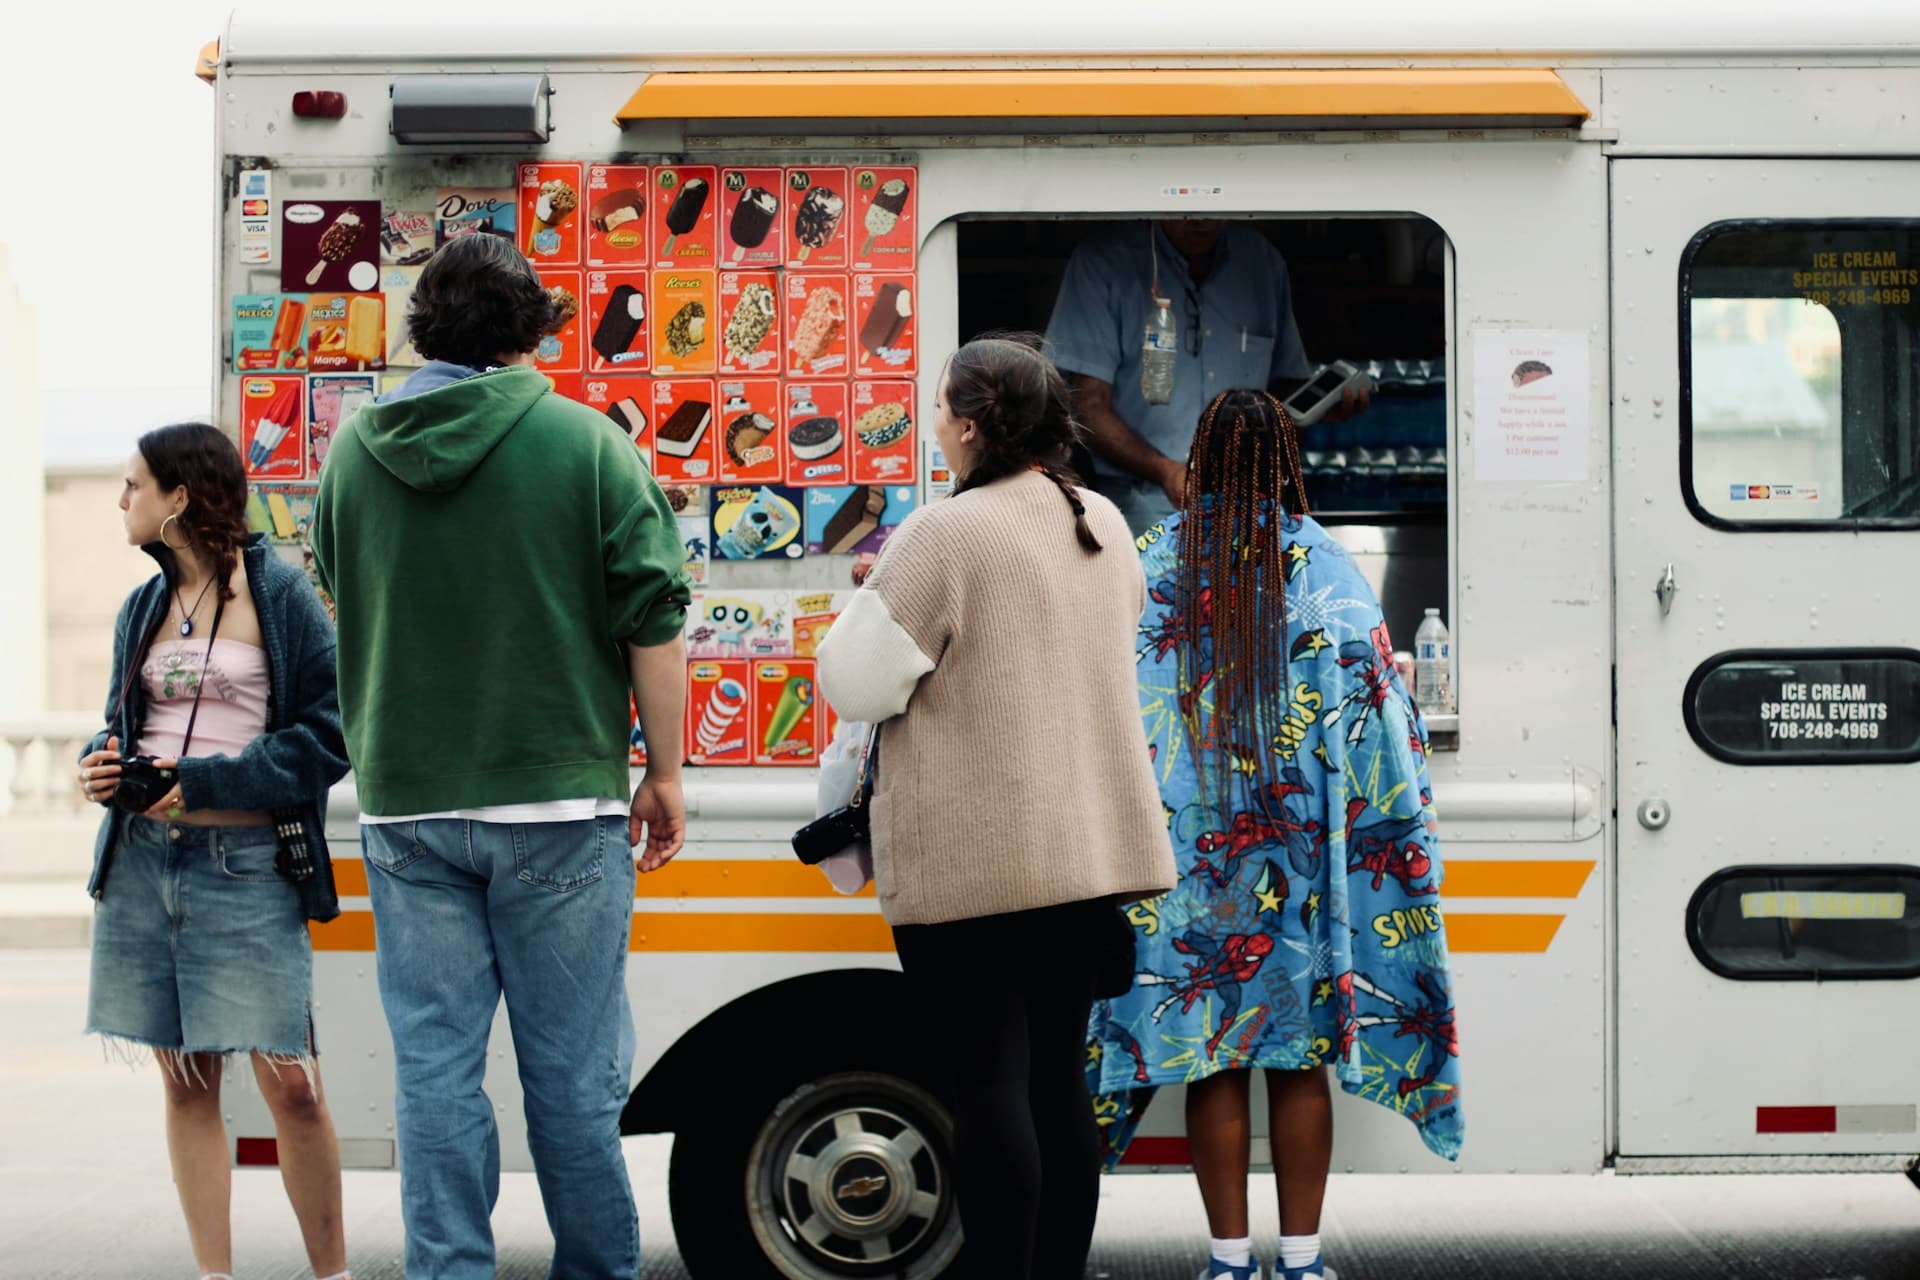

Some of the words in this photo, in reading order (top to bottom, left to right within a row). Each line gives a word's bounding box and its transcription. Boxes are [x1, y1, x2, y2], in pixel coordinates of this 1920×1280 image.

[438, 195, 510, 218] Dove
[246, 225, 267, 233] VISA
[385, 214, 428, 233] Twix
[1813, 253, 1838, 268] ICE
[1842, 251, 1897, 267] CREAM
[1793, 271, 1856, 288] SPECIAL
[1861, 269, 1919, 286] EVENTS
[313, 355, 348, 367] Mango
[1782, 683, 1807, 701] ICE
[1811, 683, 1866, 701] CREAM
[1760, 702, 1825, 720] SPECIAL
[1829, 702, 1887, 720] EVENTS
[1272, 681, 1323, 763] SPIDEY
[1769, 722, 1879, 739] 708-248-4969
[1372, 903, 1445, 949] SPIDEY
